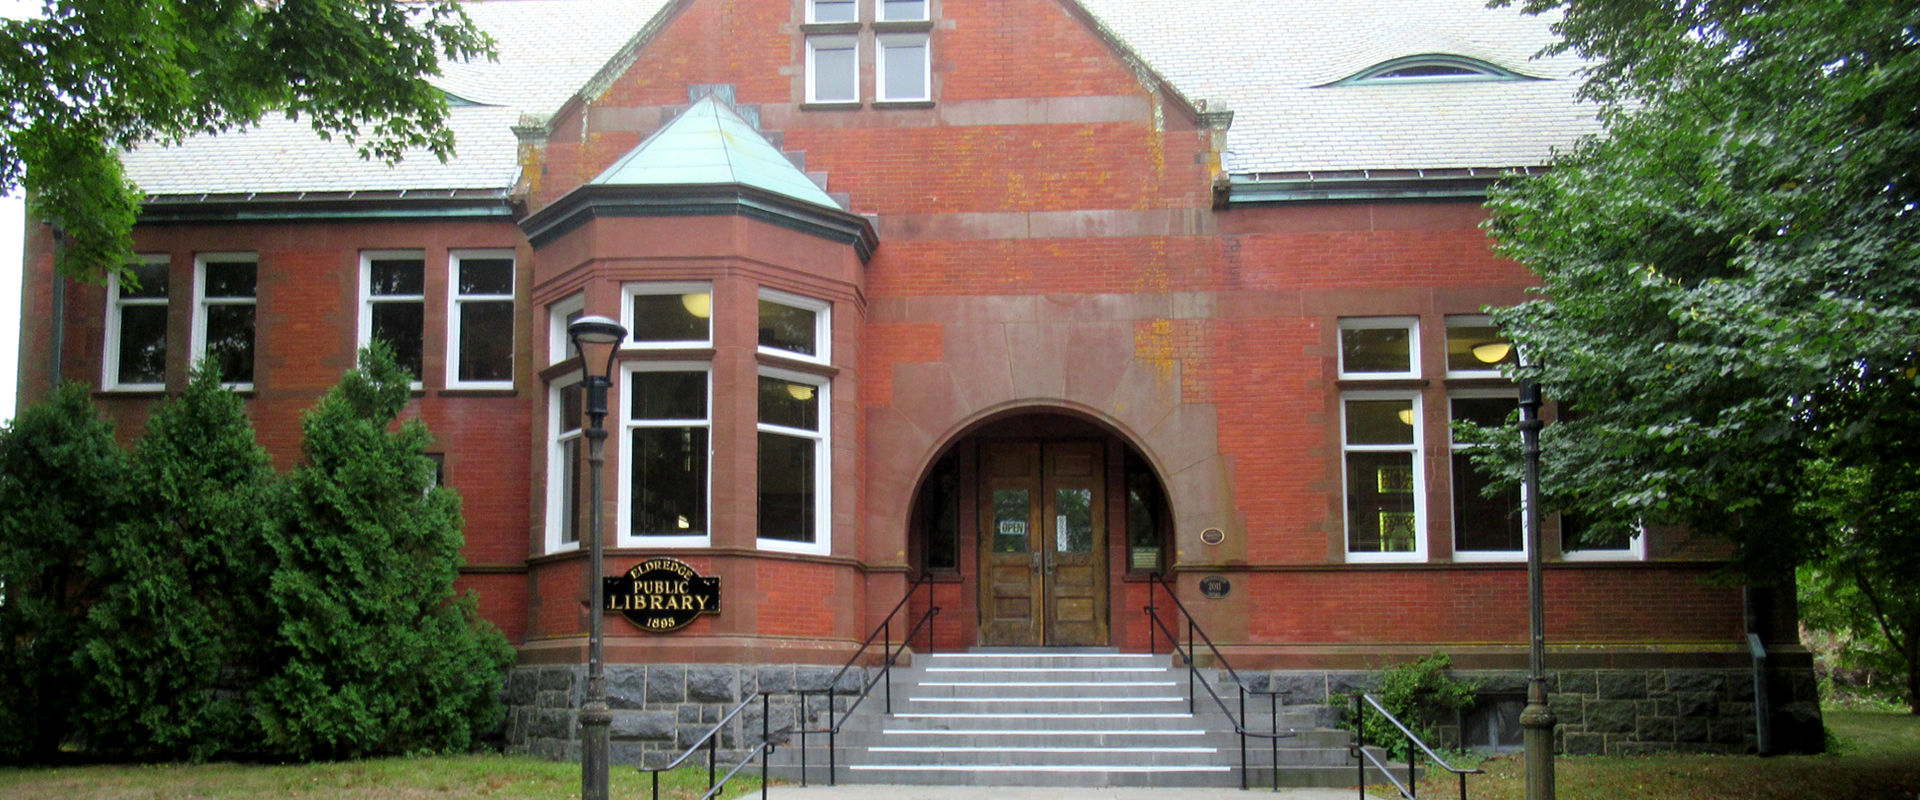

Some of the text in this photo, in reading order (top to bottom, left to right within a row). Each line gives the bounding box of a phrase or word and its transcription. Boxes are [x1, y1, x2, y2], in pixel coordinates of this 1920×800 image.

[1002, 523, 1024, 533] OPEN
[630, 560, 694, 580] ELDREDGE
[634, 581, 689, 595] PUBLIC
[611, 594, 710, 611] LIBRARY
